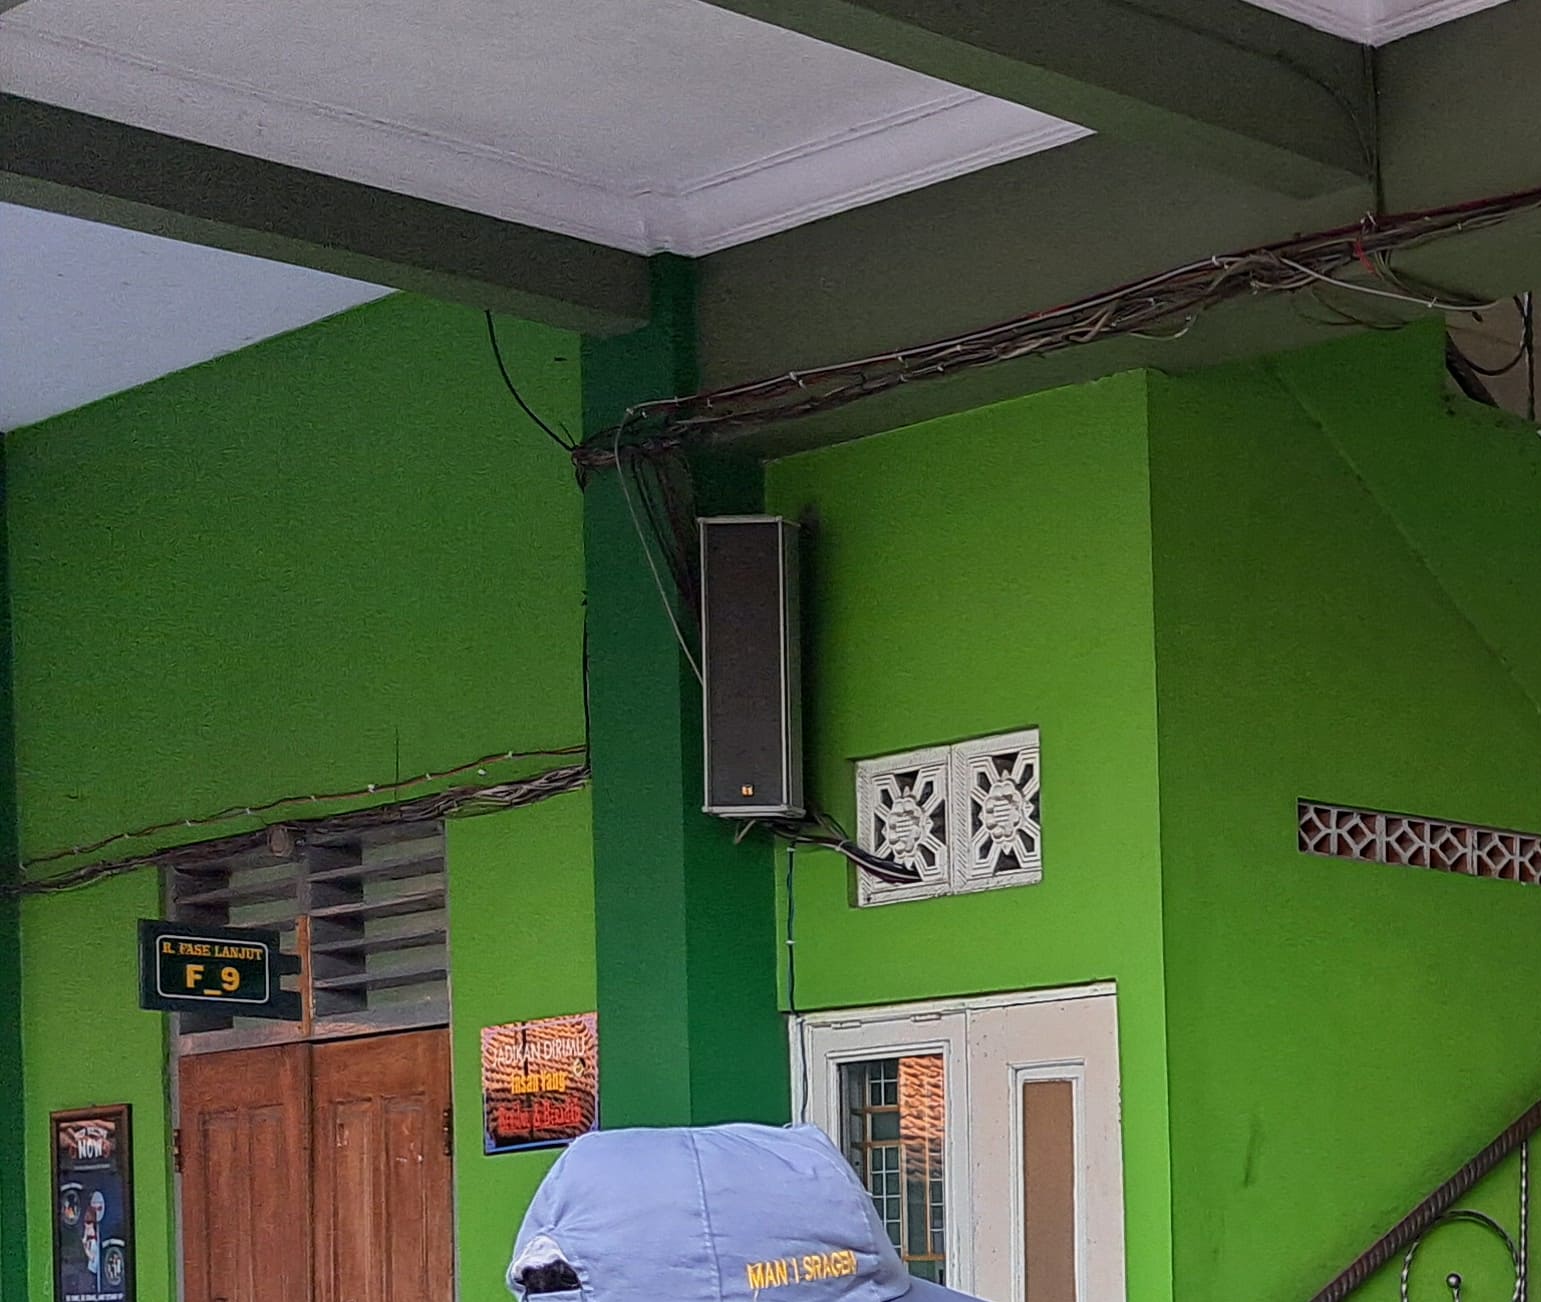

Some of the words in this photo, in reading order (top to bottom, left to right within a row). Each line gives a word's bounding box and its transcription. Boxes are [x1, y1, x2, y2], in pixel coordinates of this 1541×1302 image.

[162, 941, 176, 954] R.
[179, 942, 211, 957] FASE
[214, 945, 264, 961] LANJUT
[185, 963, 241, 996] F_9
[492, 1041, 541, 1066] JADIKAN
[544, 1035, 586, 1060] DIRIMU
[511, 1073, 540, 1095] Insan
[541, 1070, 568, 1092] Yang
[77, 1138, 103, 1160] NOW
[746, 1258, 789, 1290] MAN
[792, 1257, 800, 1284] 1
[803, 1249, 857, 1281] SRAGEN
